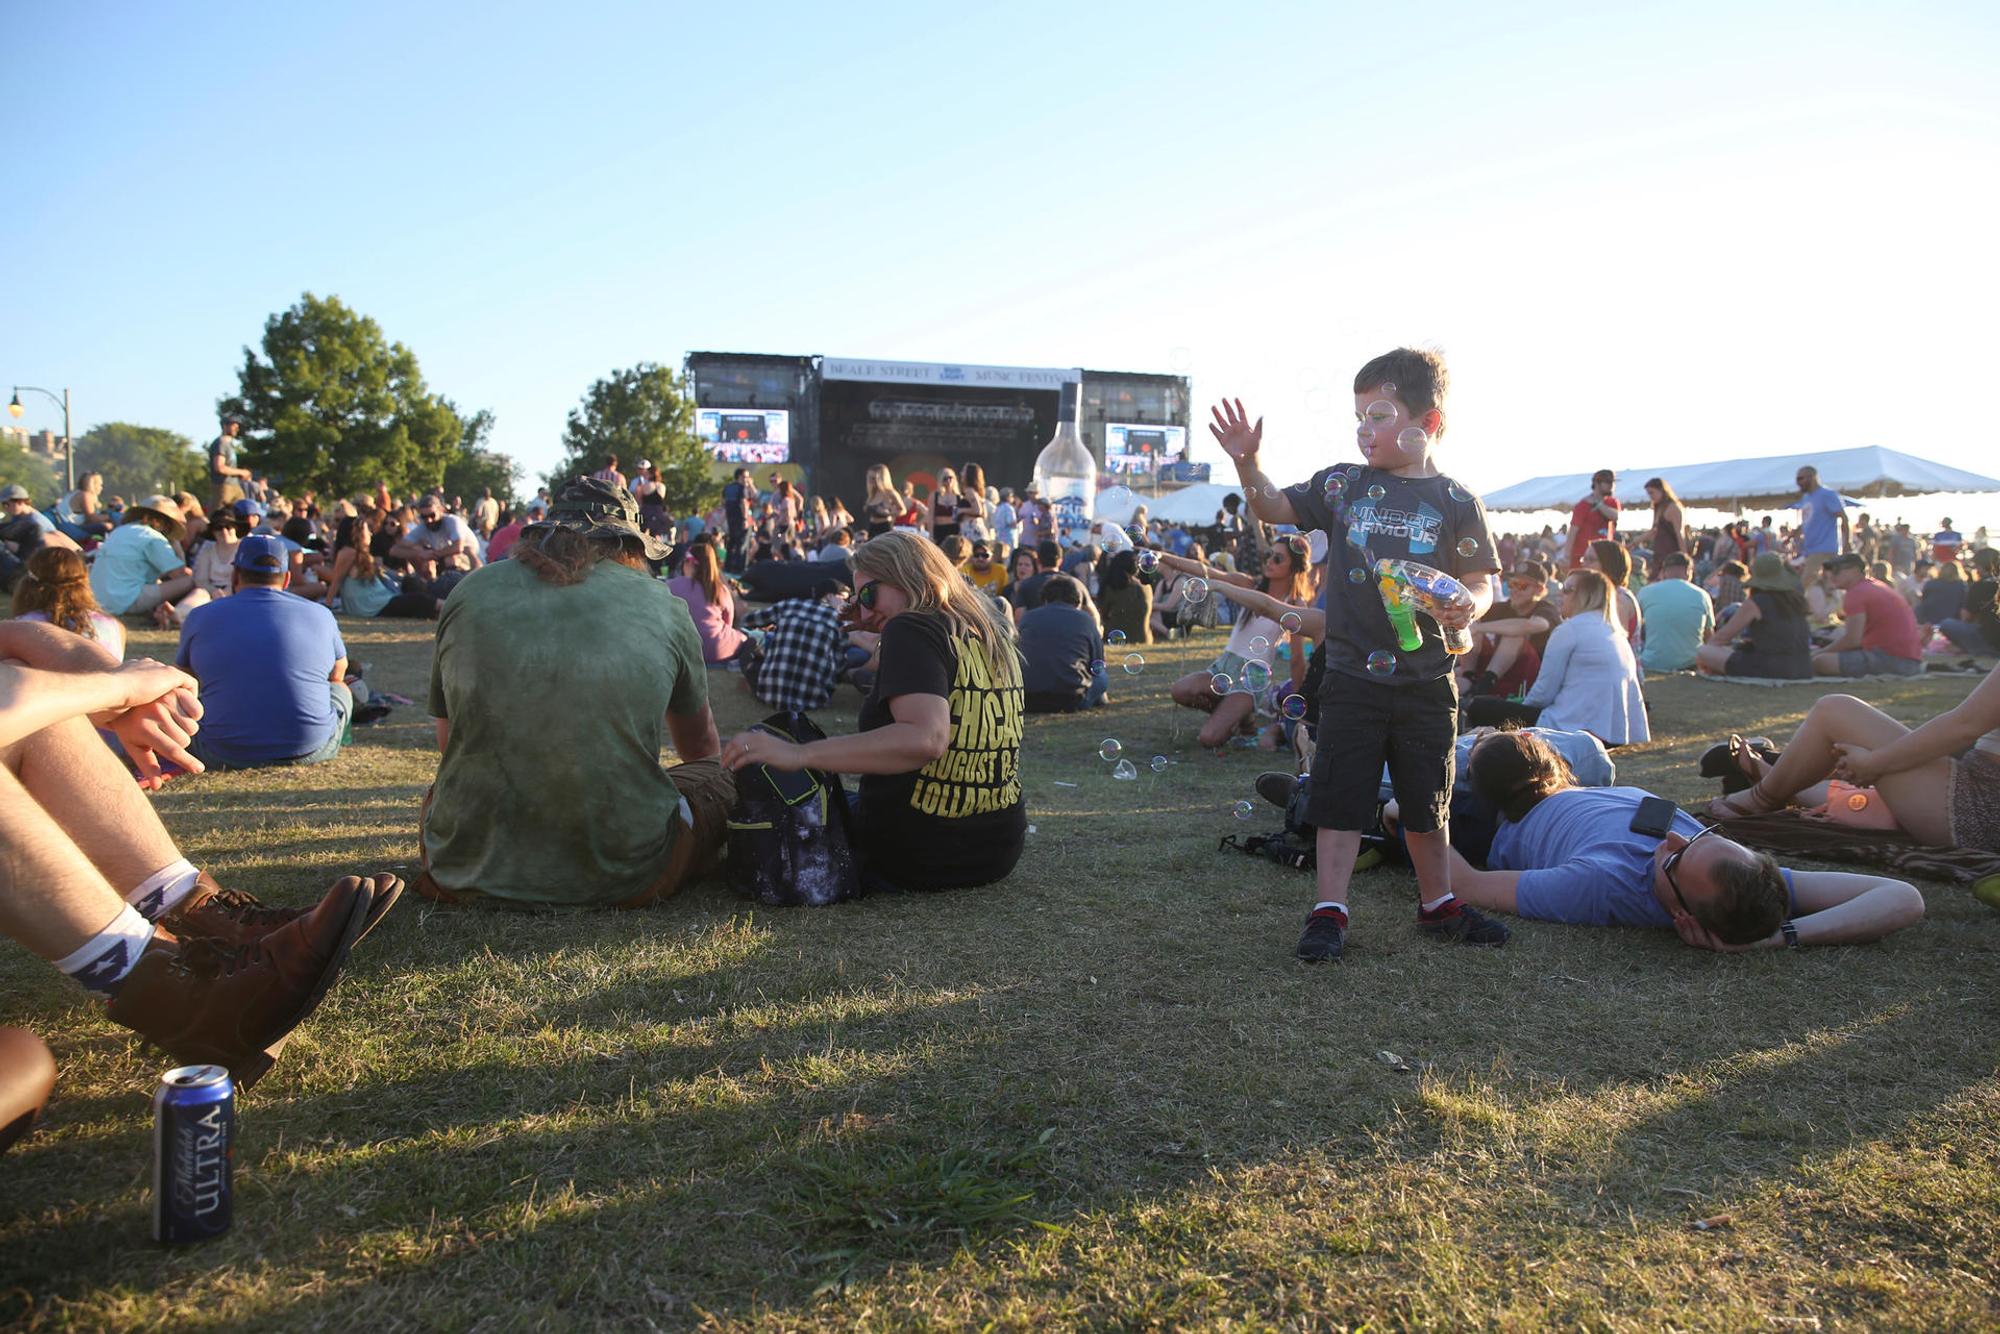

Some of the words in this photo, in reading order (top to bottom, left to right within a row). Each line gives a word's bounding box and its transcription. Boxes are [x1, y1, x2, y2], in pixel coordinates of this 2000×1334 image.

[1350, 521, 1439, 546] ARMOUR
[1351, 506, 1442, 534] UNDER
[920, 750, 997, 784] AUGUST
[195, 1104, 221, 1216] ULTRA
